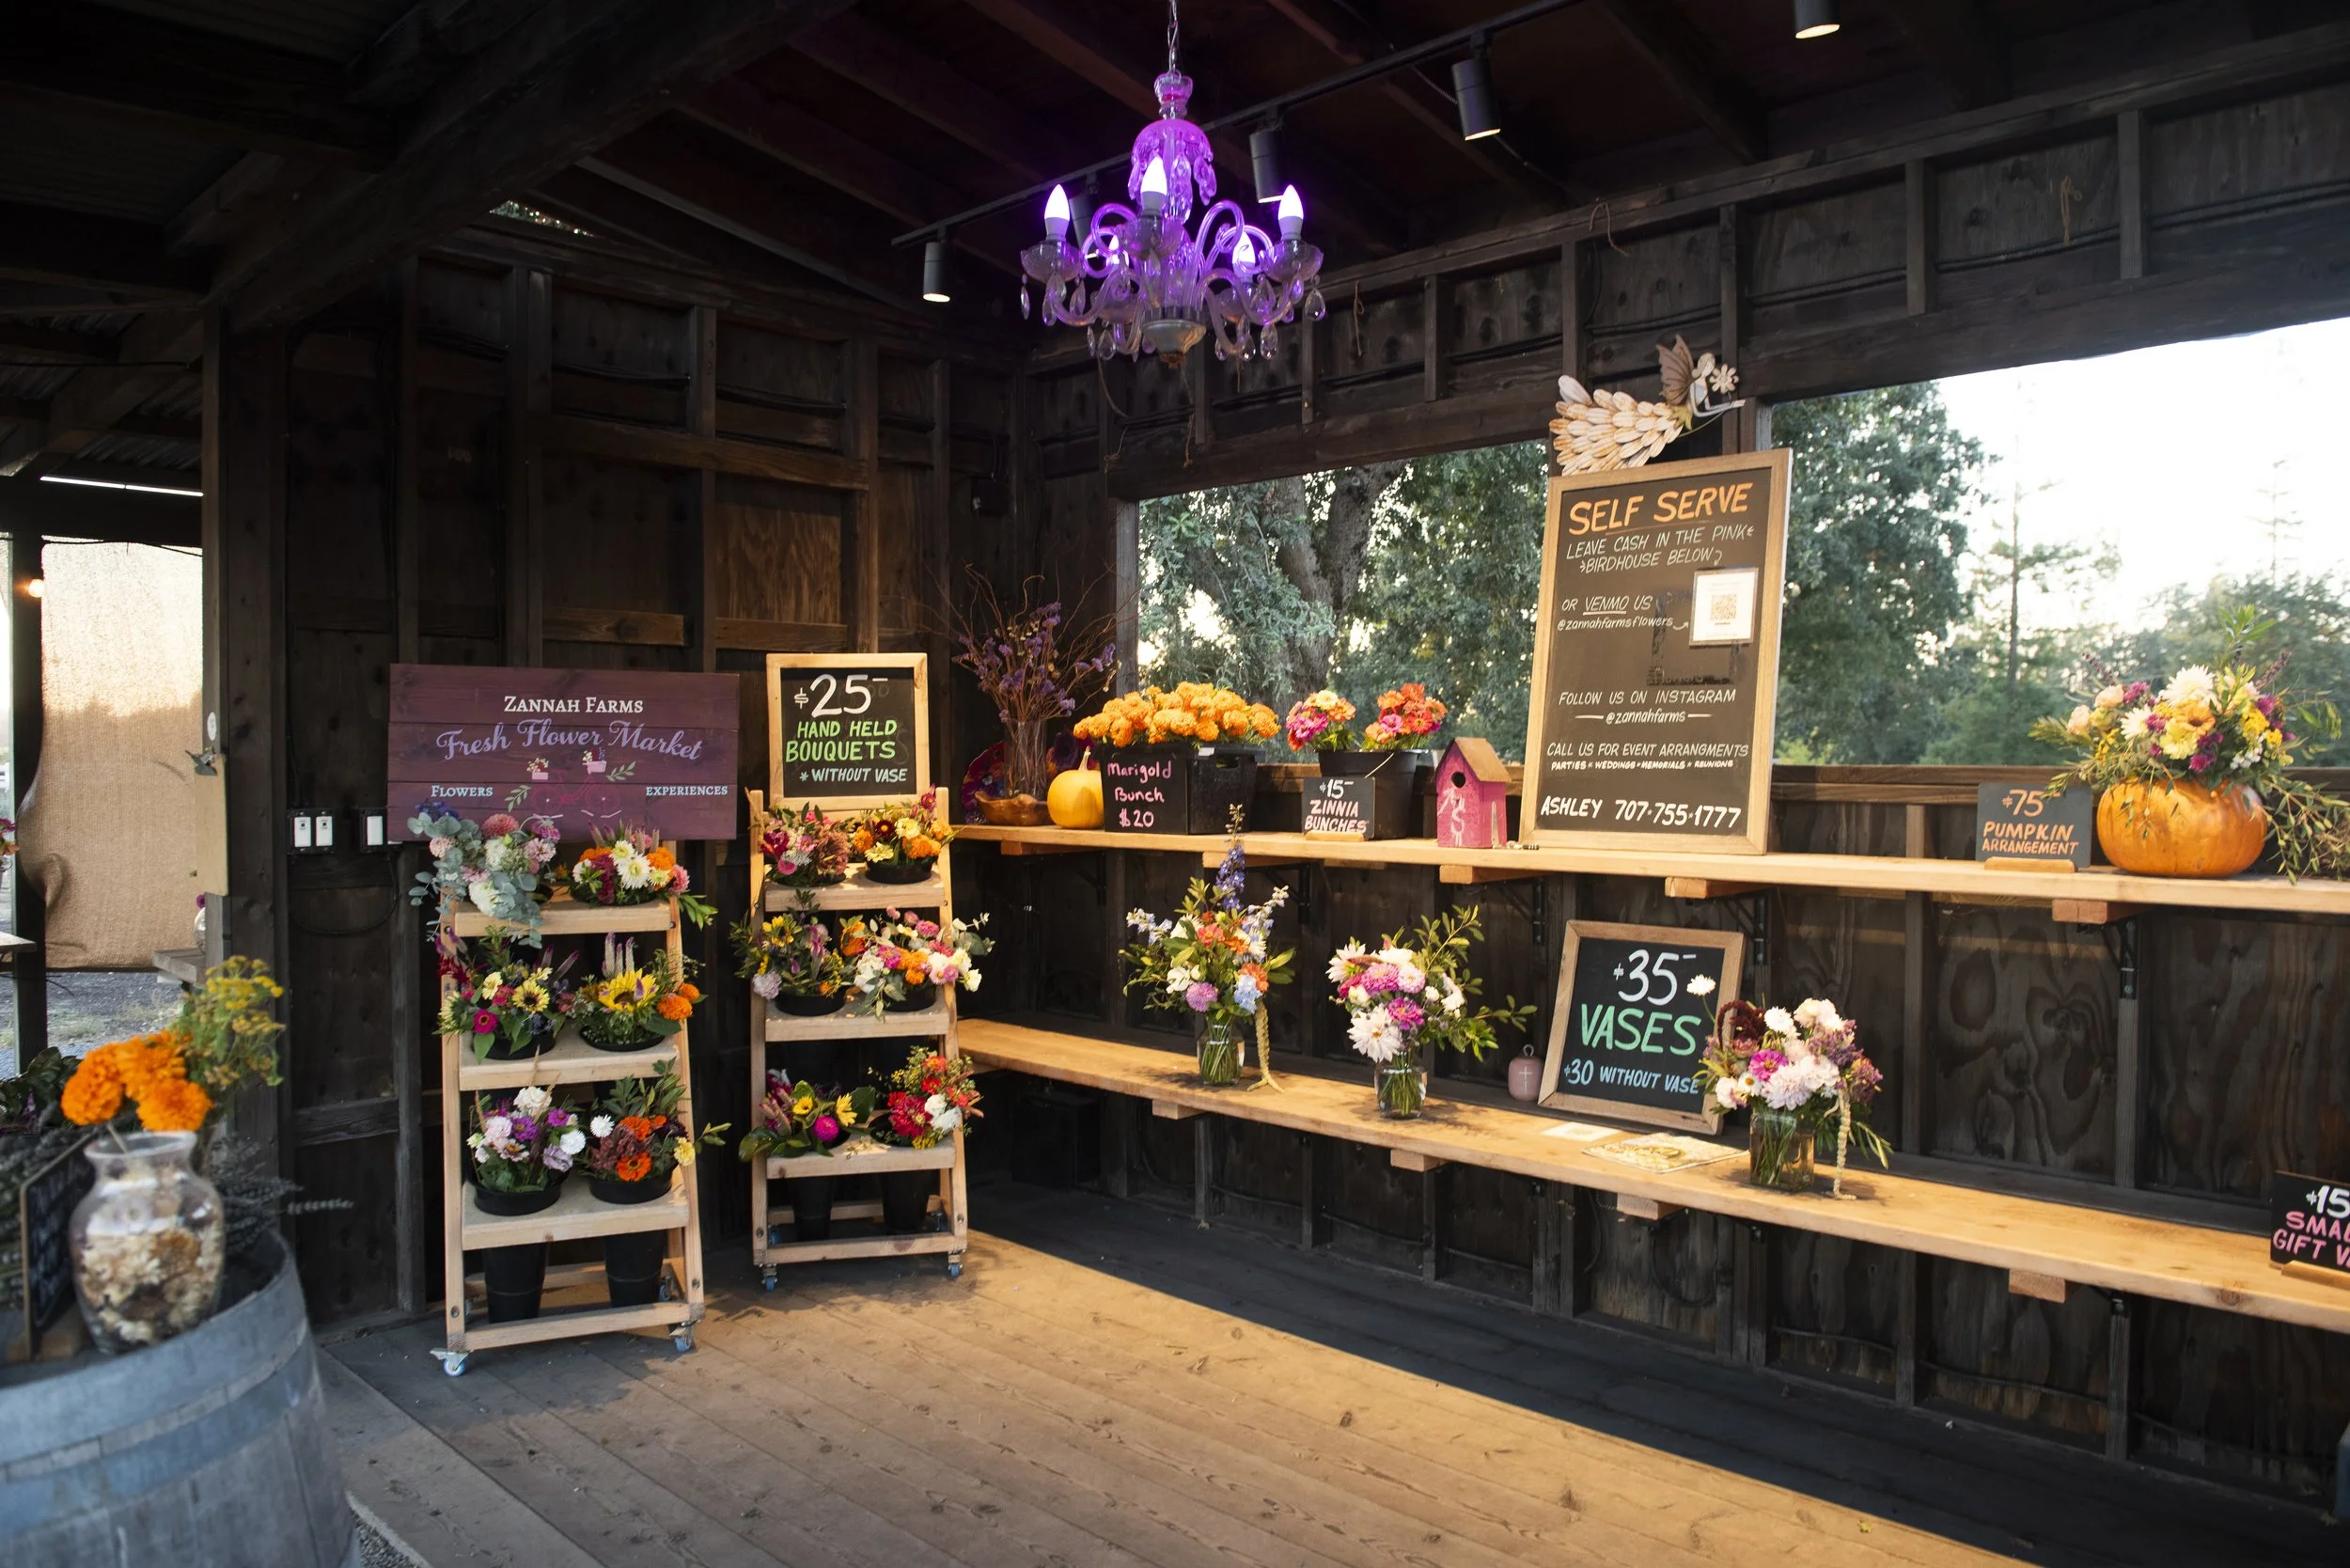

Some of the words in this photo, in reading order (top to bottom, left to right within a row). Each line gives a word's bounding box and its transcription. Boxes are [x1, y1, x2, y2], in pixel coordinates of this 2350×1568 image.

[1568, 495, 1644, 536] SELF
[1653, 482, 1754, 523] SERVE
[1566, 538, 1607, 560] LEAVE
[1613, 534, 1650, 553] CASH
[1655, 531, 1669, 548] IN
[1675, 526, 1706, 545] THE
[1712, 523, 1747, 542] PINK
[1585, 551, 1662, 574] BIRDHOUSE
[1667, 546, 1715, 564] BELOW
[1561, 598, 1578, 612] OR
[1584, 595, 1629, 612] VENMO
[1633, 595, 1653, 611] US
[1557, 615, 1674, 632] @zannahfarmsflowers
[504, 696, 580, 713] ZANNAH
[585, 697, 644, 713] FARMS
[1559, 691, 1603, 706] FOLLOW
[1608, 691, 1624, 705] US
[1630, 690, 1649, 704] ON
[1654, 688, 1737, 704] INSTAGRAM
[1606, 708, 1686, 725] @zannahfarms
[436, 722, 511, 760] Fresh
[517, 717, 603, 747] Flower
[607, 719, 705, 760] Market
[797, 720, 841, 739] HAND
[849, 719, 898, 737] HELD
[785, 740, 896, 763] BOUQUETS
[1546, 742, 1574, 757] CALL
[1578, 742, 1594, 758] US
[1598, 743, 1620, 757] FOR
[1622, 743, 1657, 757] EVENT
[1658, 742, 1749, 758] ARRANGMENTS
[875, 767, 908, 783] VASE
[1107, 760, 1173, 784] Marigold
[1551, 760, 1587, 771] PARTIES
[1594, 760, 1637, 770] WEDDINGS
[1640, 760, 1685, 770] MEMORIALS
[1694, 759, 1734, 769] REUNIONS
[431, 784, 494, 798] FLOWERS
[645, 784, 728, 797] EXPERIENCES
[1114, 786, 1165, 804] Bunch
[1309, 799, 1359, 818] ZINNIA
[1540, 795, 1604, 819] ASHLEY
[1119, 808, 1154, 828] $20
[1304, 814, 1369, 834] BUNCHES
[1982, 820, 2075, 842] PUMPKIN
[1982, 837, 2079, 855] ARRANGEMENT
[1580, 1003, 1702, 1057] VASES
[1563, 1058, 1594, 1086] $30
[1599, 1064, 1661, 1090] WITHOUT
[1664, 1074, 1700, 1094] VASE
[2272, 1228, 2327, 1260] GIFT
